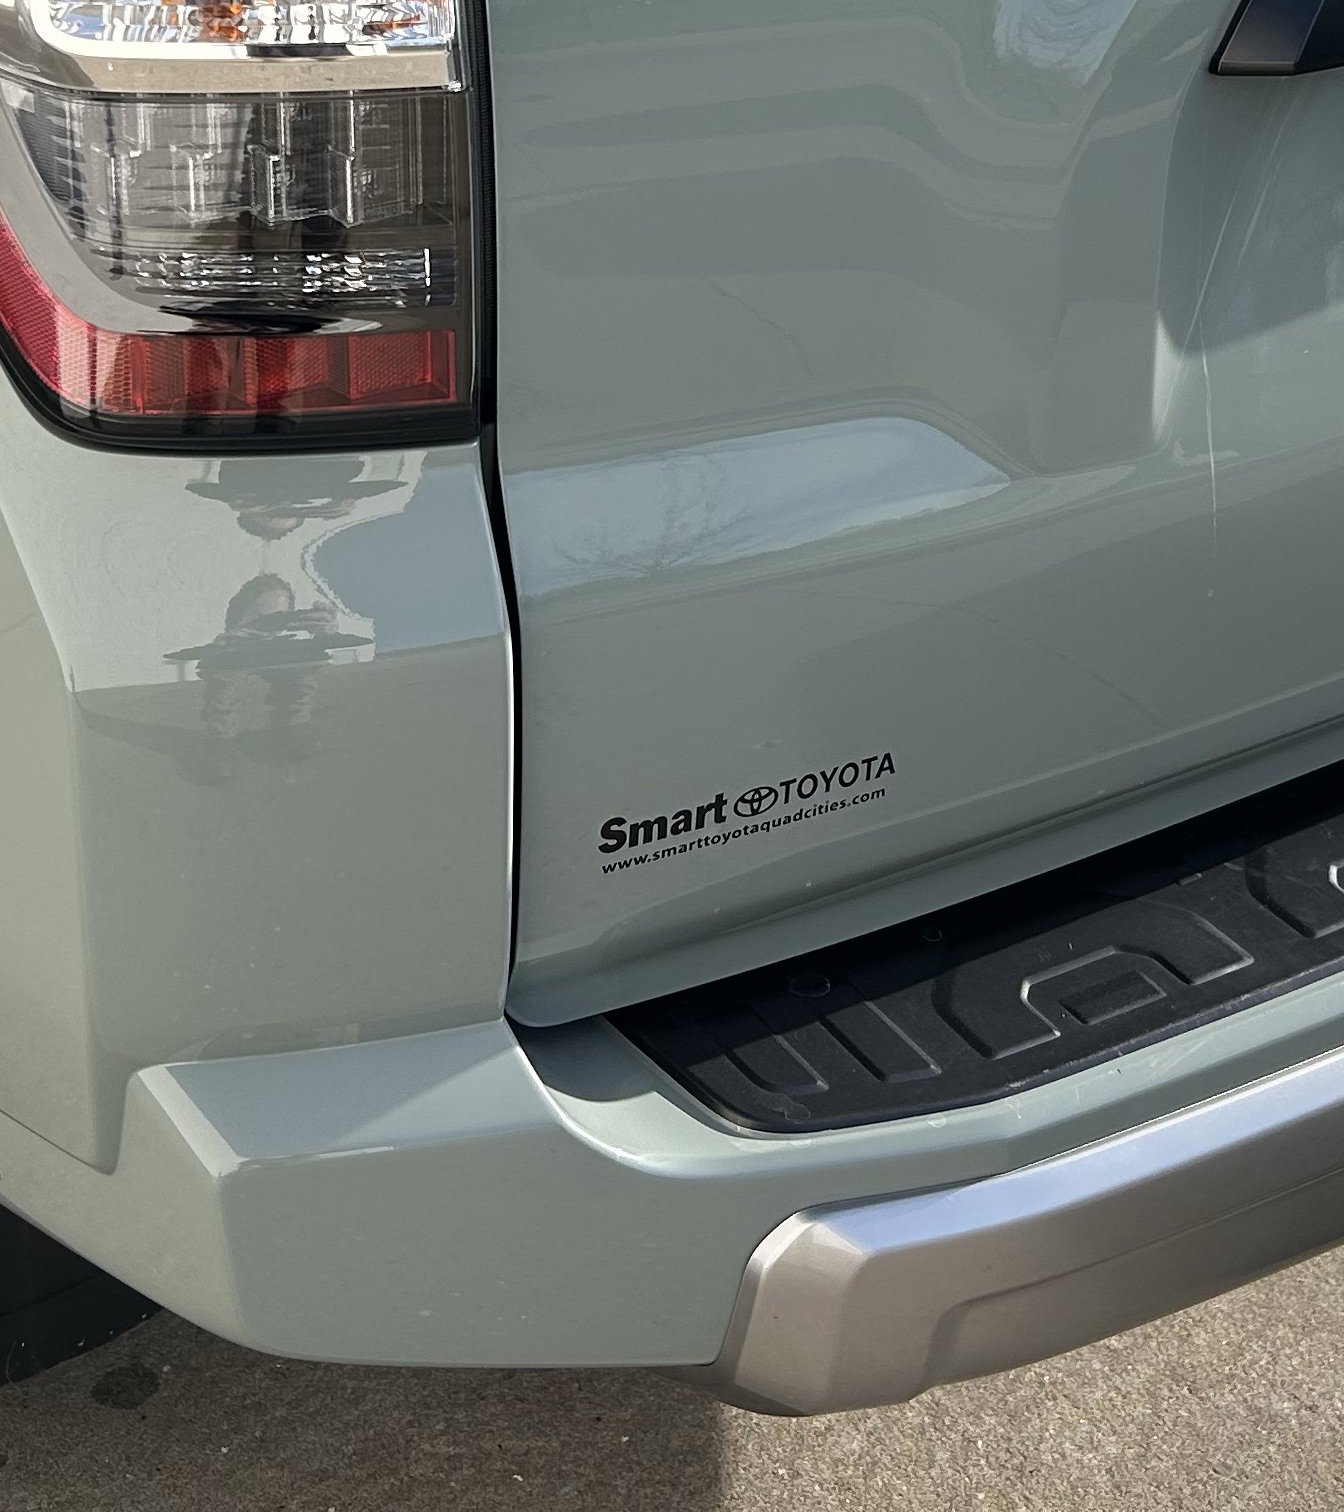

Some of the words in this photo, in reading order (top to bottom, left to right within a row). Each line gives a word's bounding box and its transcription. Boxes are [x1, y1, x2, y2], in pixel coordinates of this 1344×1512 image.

[598, 792, 728, 854] Smart
[779, 752, 896, 805] TOYOTA
[601, 787, 887, 875] www.smarttoyotaquadcities.com
